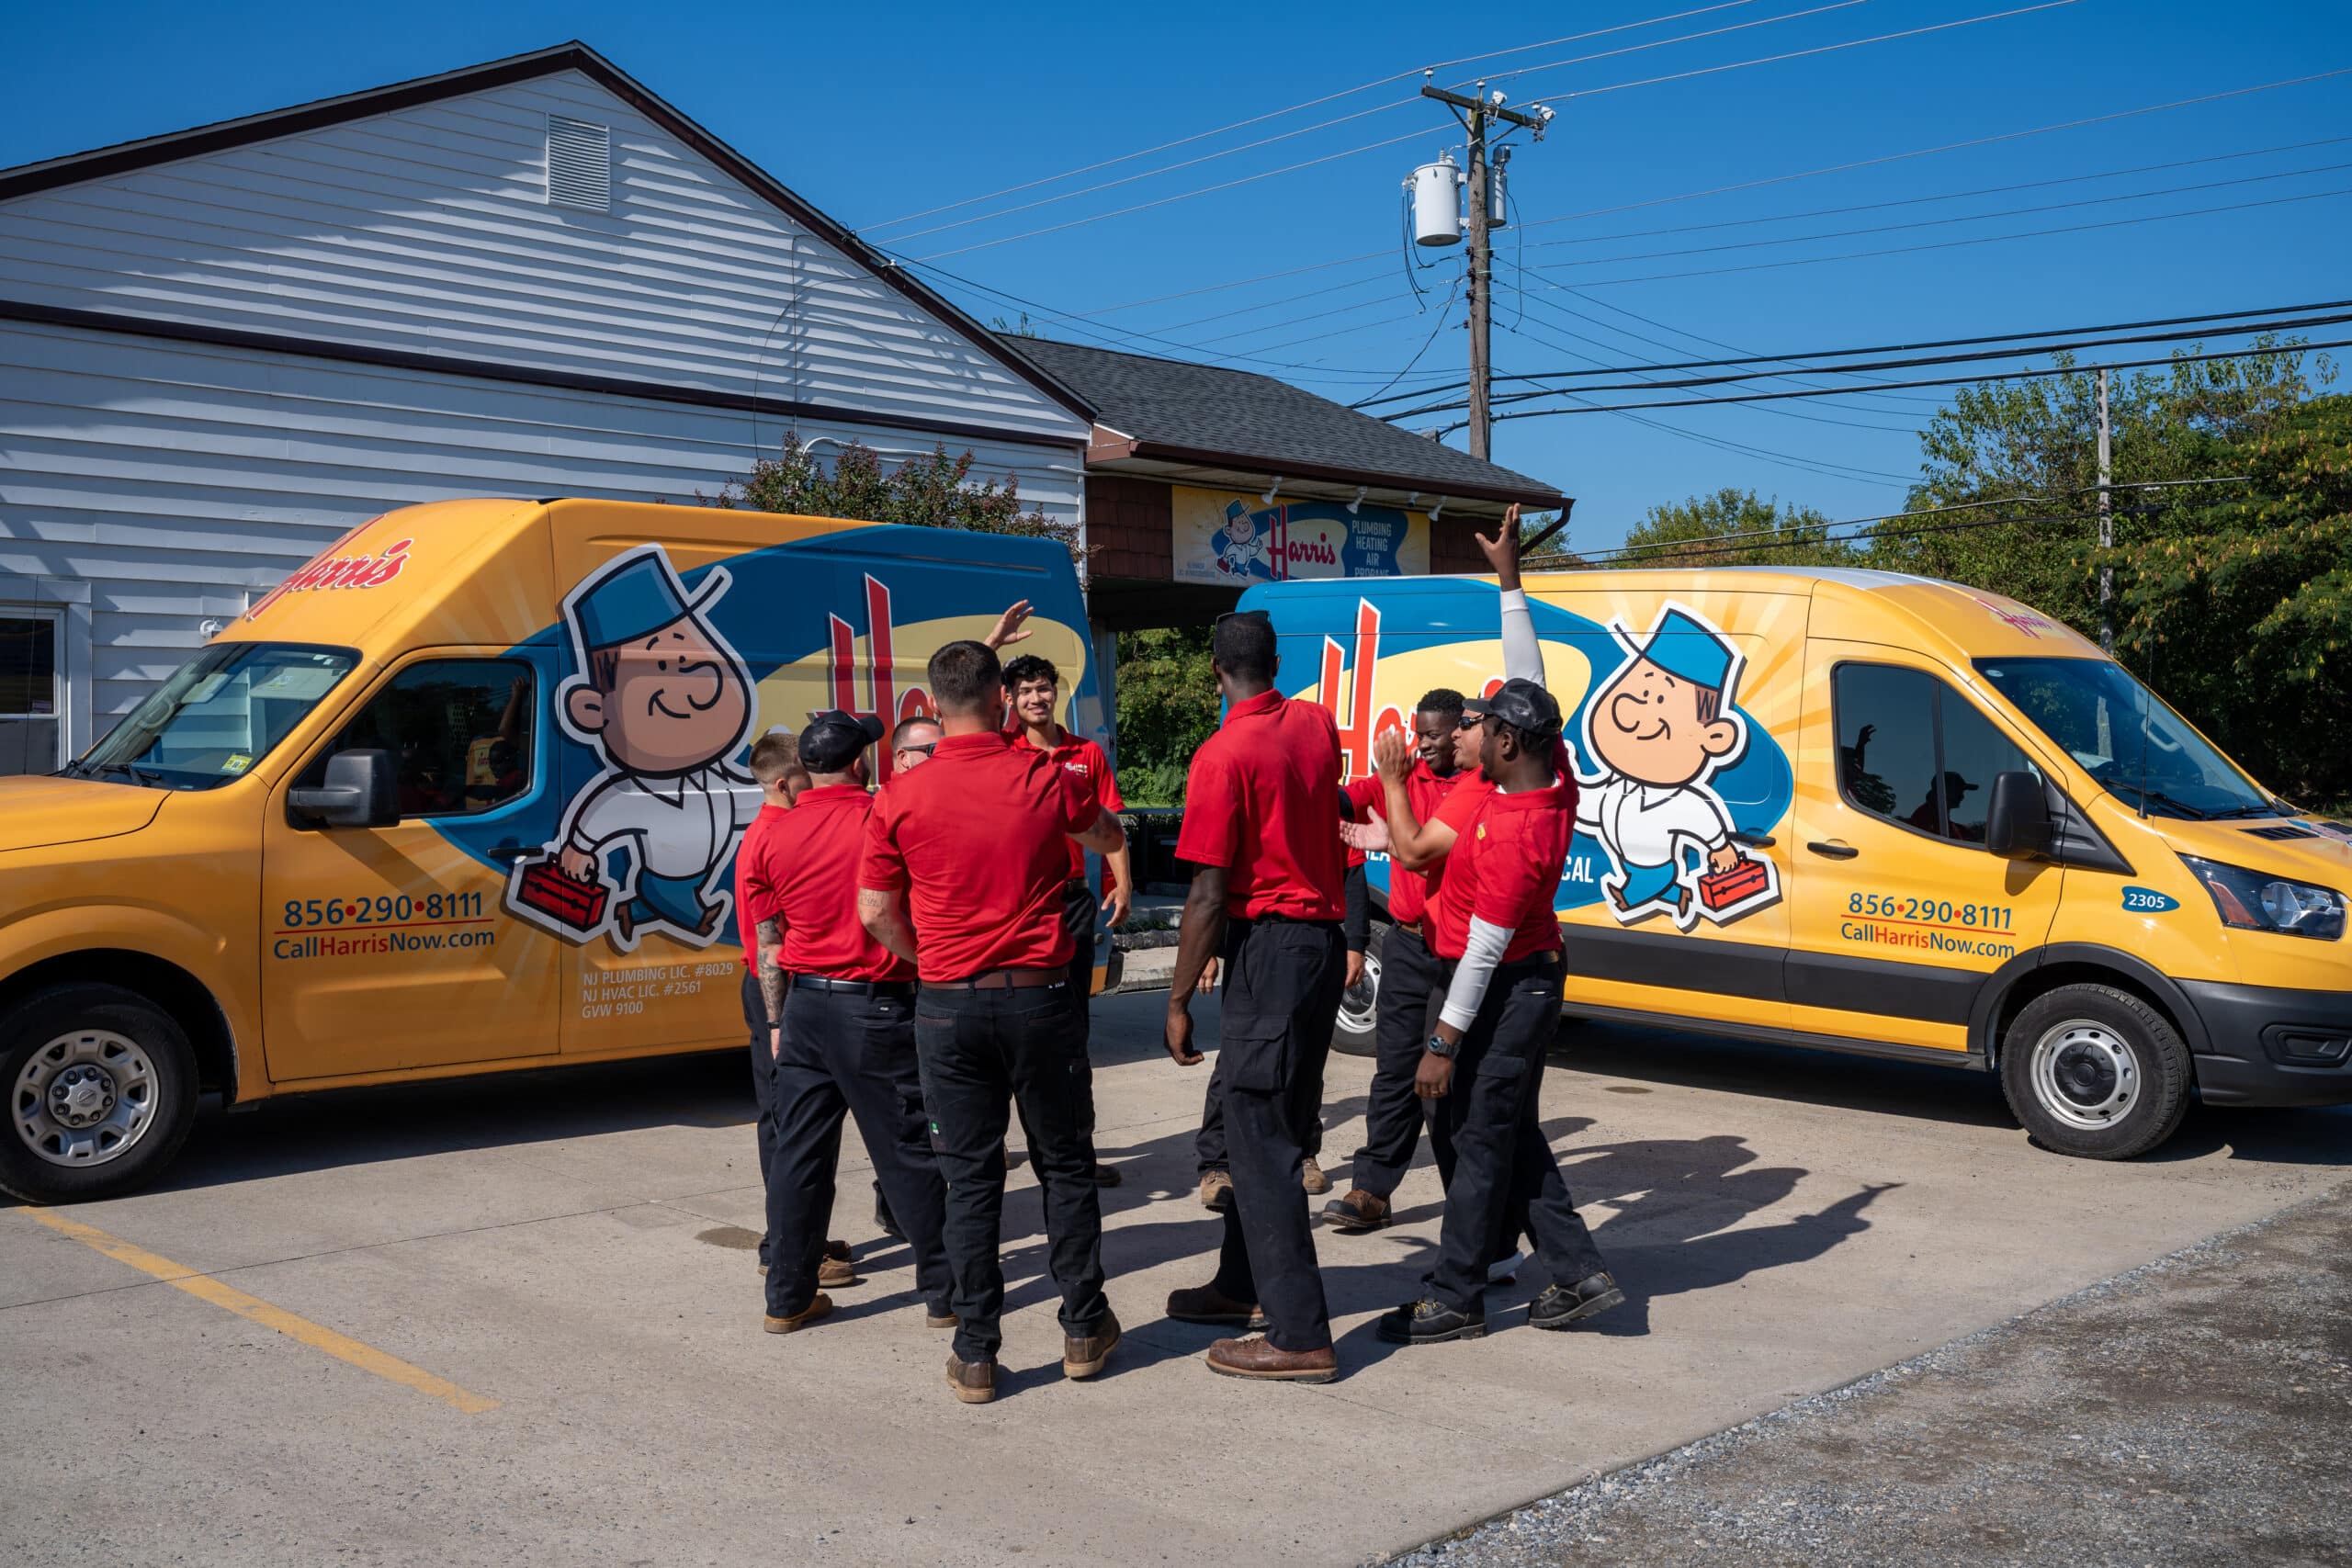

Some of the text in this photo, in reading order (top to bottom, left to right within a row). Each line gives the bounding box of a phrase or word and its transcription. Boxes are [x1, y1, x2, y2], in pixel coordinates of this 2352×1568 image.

[1351, 520, 1393, 536] PLUMBING
[1266, 502, 1336, 581] Harris
[1355, 536, 1388, 551] HEATING
[1366, 552, 1380, 566] AIR
[2128, 893, 2165, 908] 2305
[274, 931, 495, 960] CallHarrisNow.com
[1841, 922, 2015, 958] CallHarrisNow.com
[583, 963, 734, 986] NJ PLUMBING LIC. #8029
[582, 980, 702, 1002] NJ HVAC LIC. #2561
[582, 1001, 643, 1019] GVW 9100
